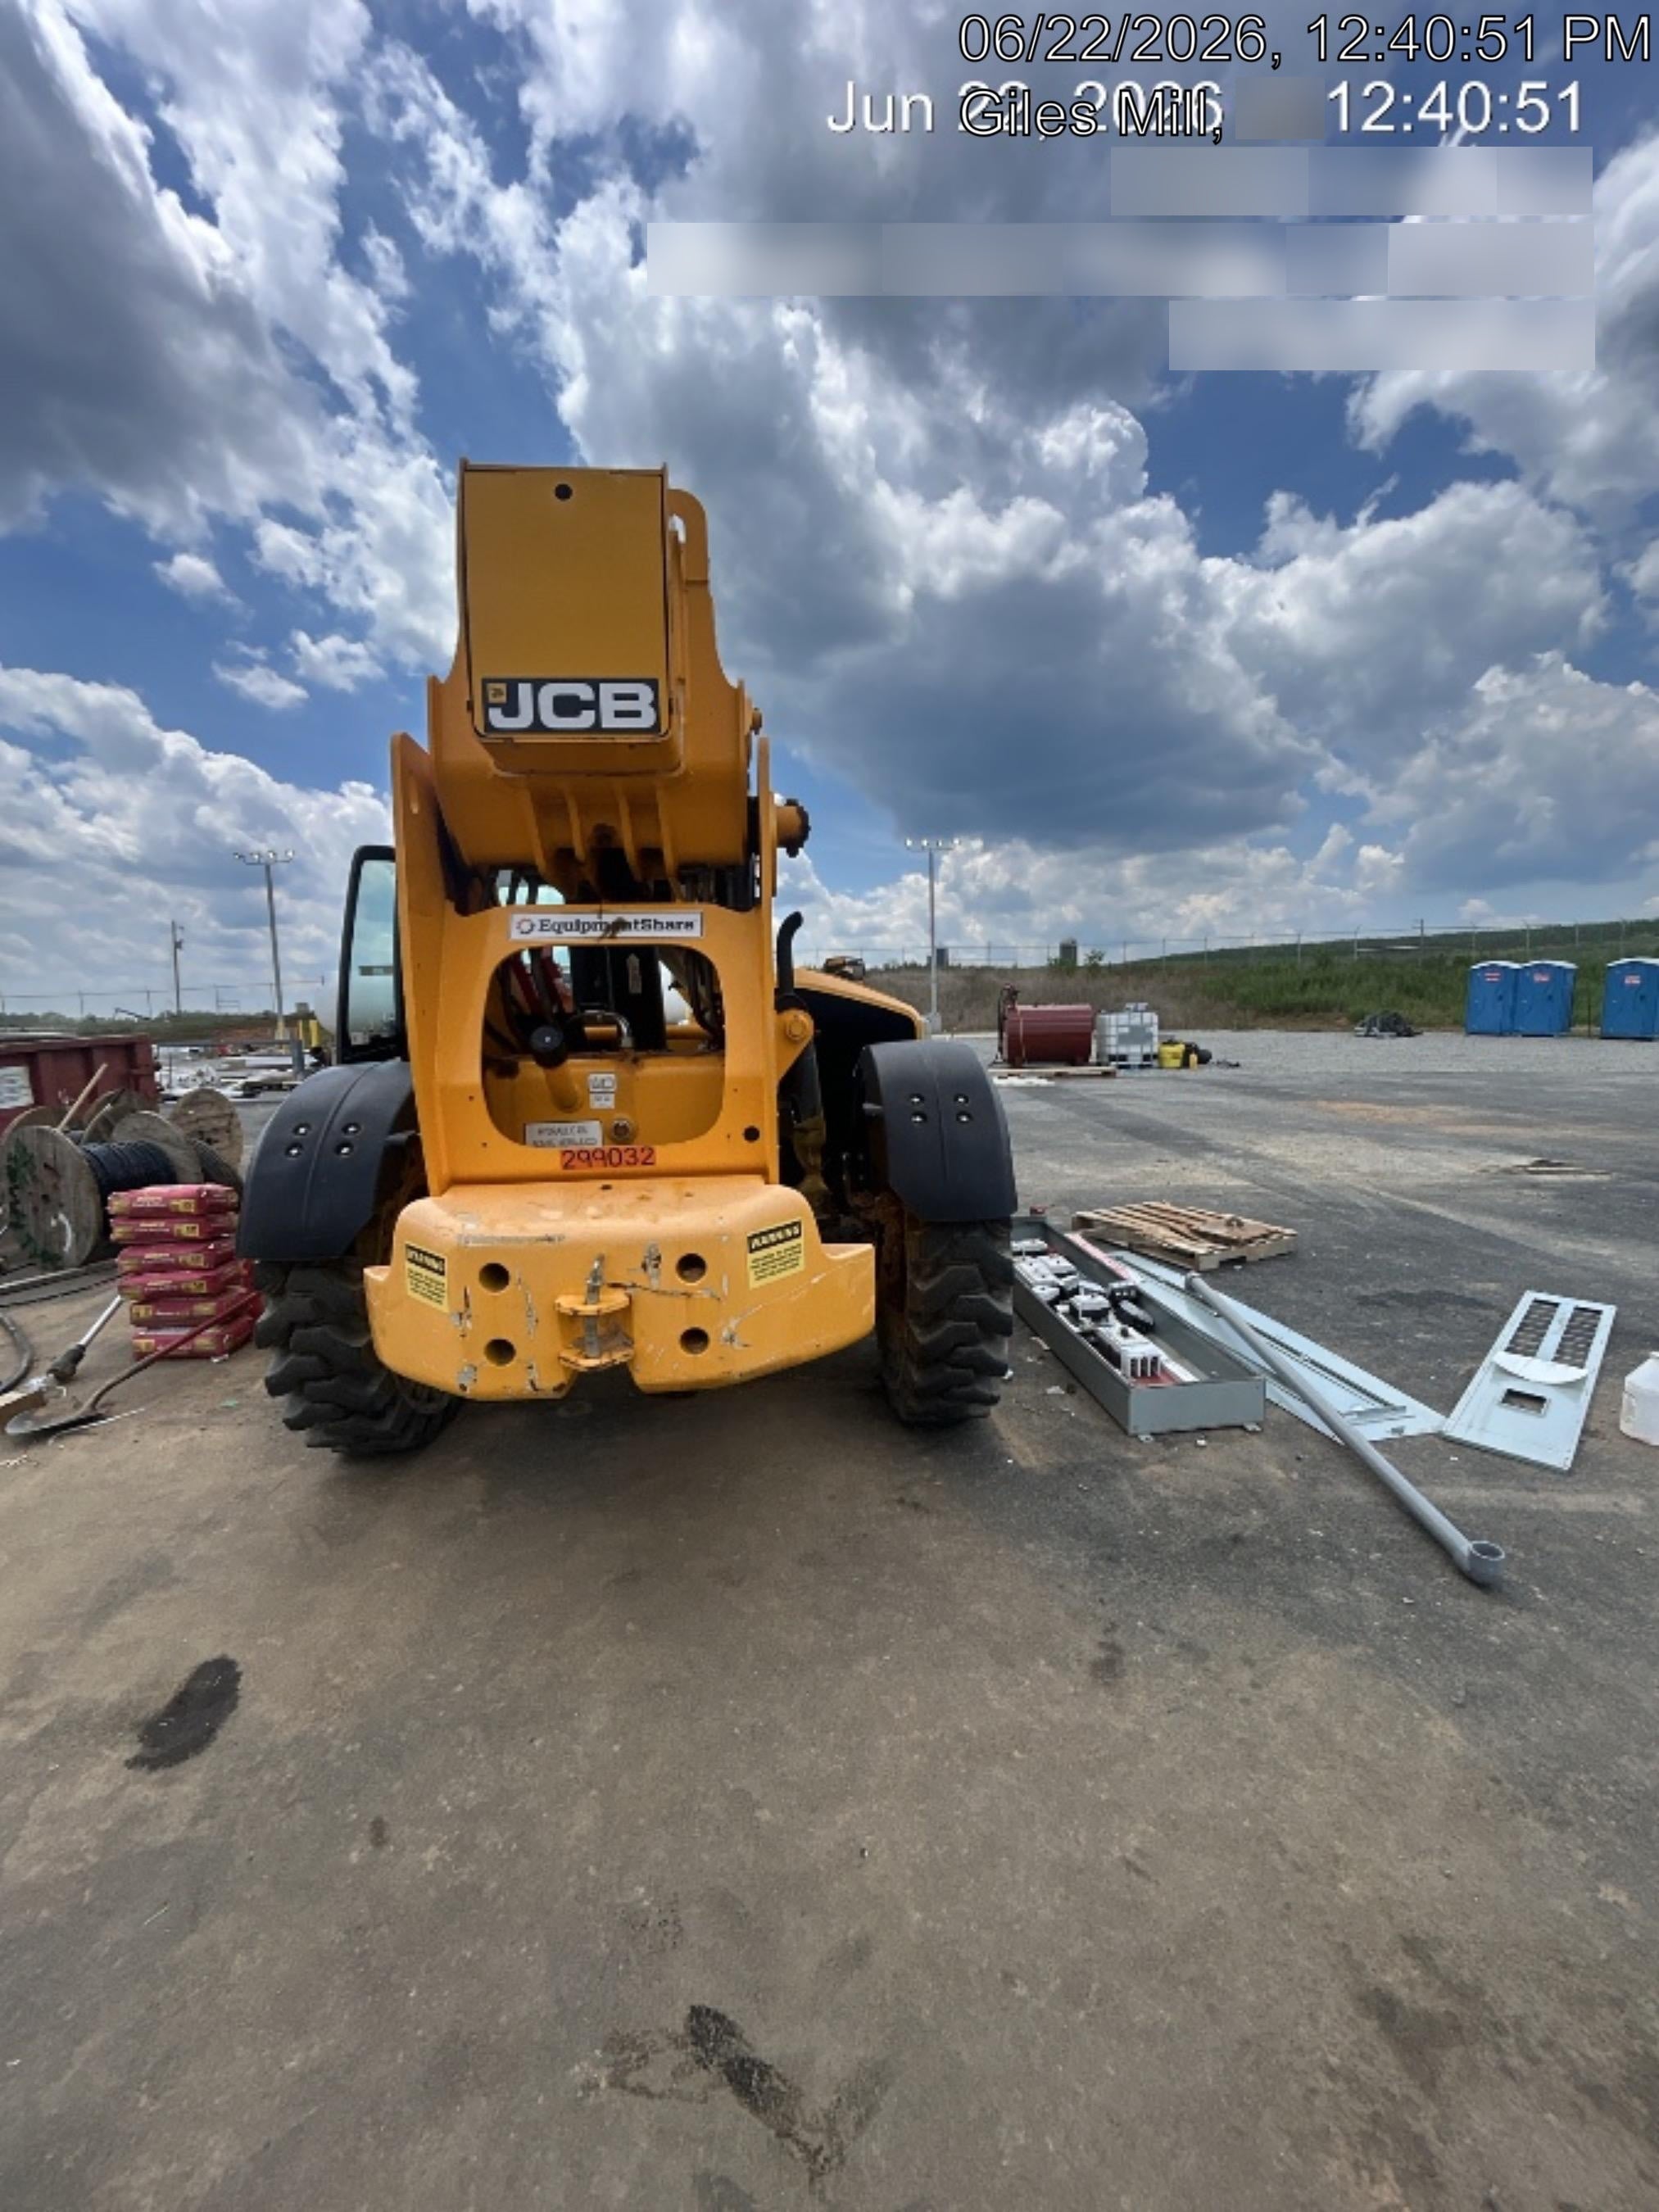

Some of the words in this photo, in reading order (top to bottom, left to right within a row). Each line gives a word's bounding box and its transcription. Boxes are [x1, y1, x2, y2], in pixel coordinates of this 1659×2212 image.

[487, 682, 657, 729] JCB
[537, 918, 695, 935] EquipmntShare
[562, 1147, 655, 1170] 299032
